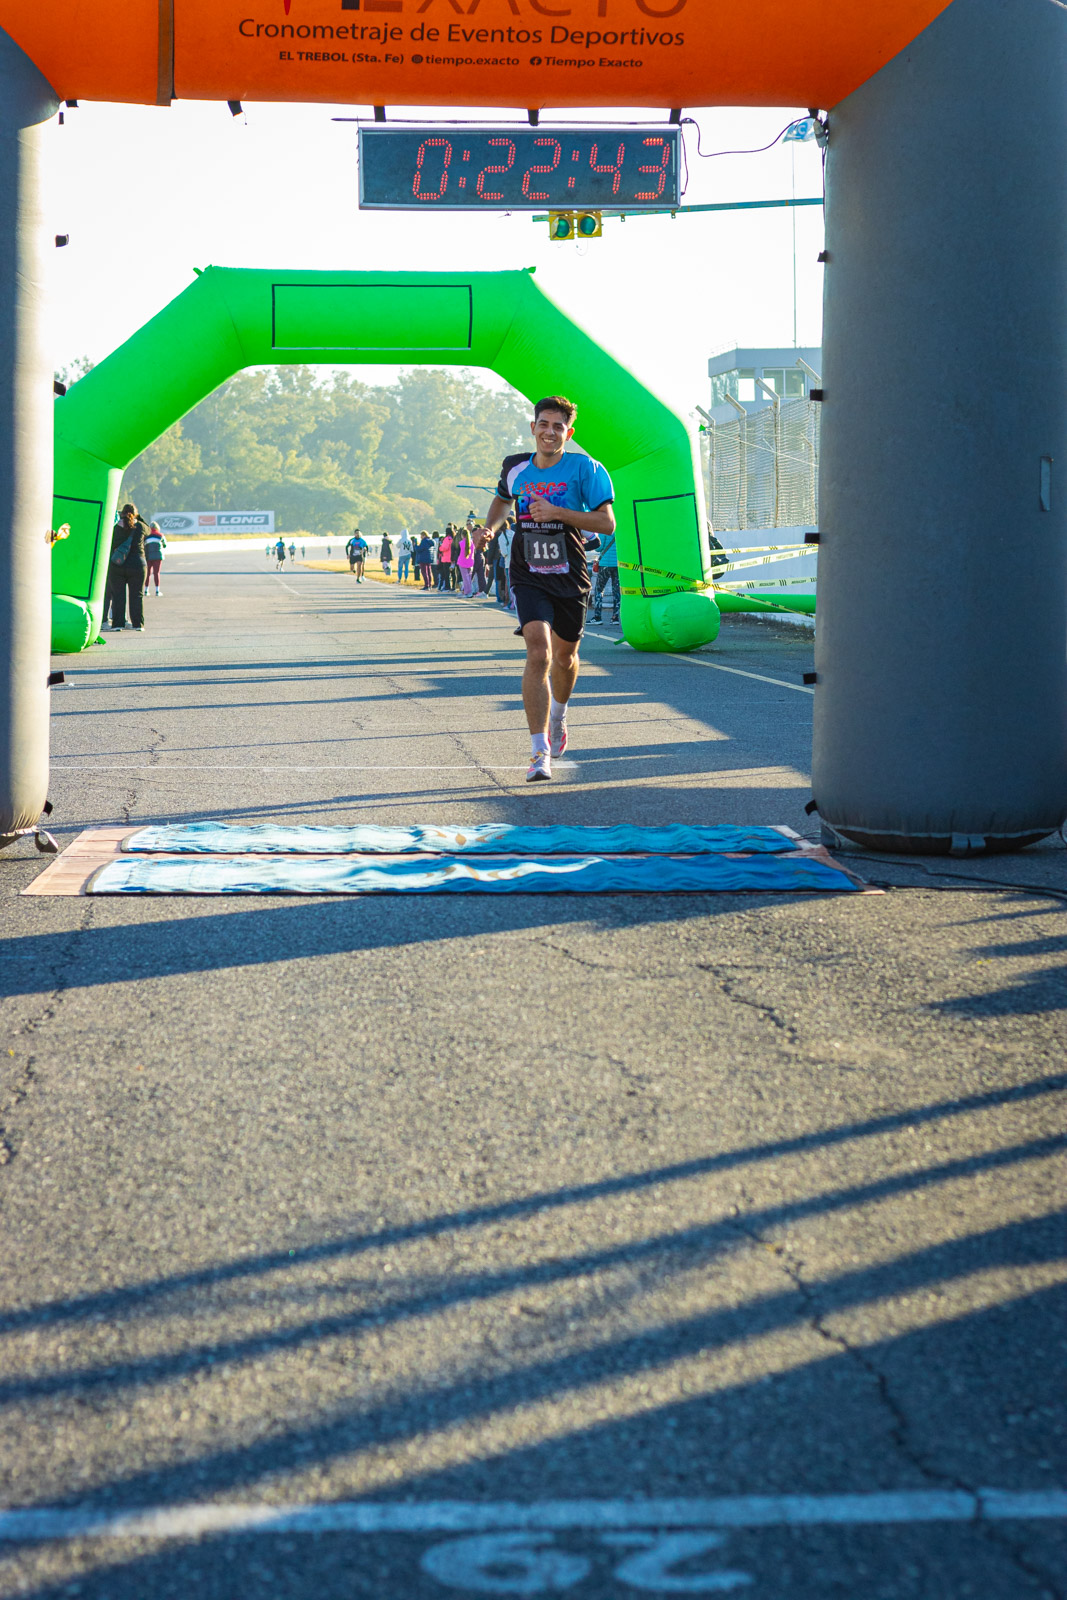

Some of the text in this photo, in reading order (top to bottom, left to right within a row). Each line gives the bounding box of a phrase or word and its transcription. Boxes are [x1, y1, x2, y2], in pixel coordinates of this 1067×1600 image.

[238, 18, 685, 49] Cronometraje de Eventos Deportivos
[279, 51, 404, 64] EL TREBOL (Sta. Fe)
[425, 54, 520, 67] tiempo.exacto
[544, 56, 643, 69] Tiempo Exacto
[412, 137, 671, 201] 0:22:43
[161, 517, 186, 528] Ford
[219, 515, 266, 525] LONG
[533, 541, 559, 559] 113
